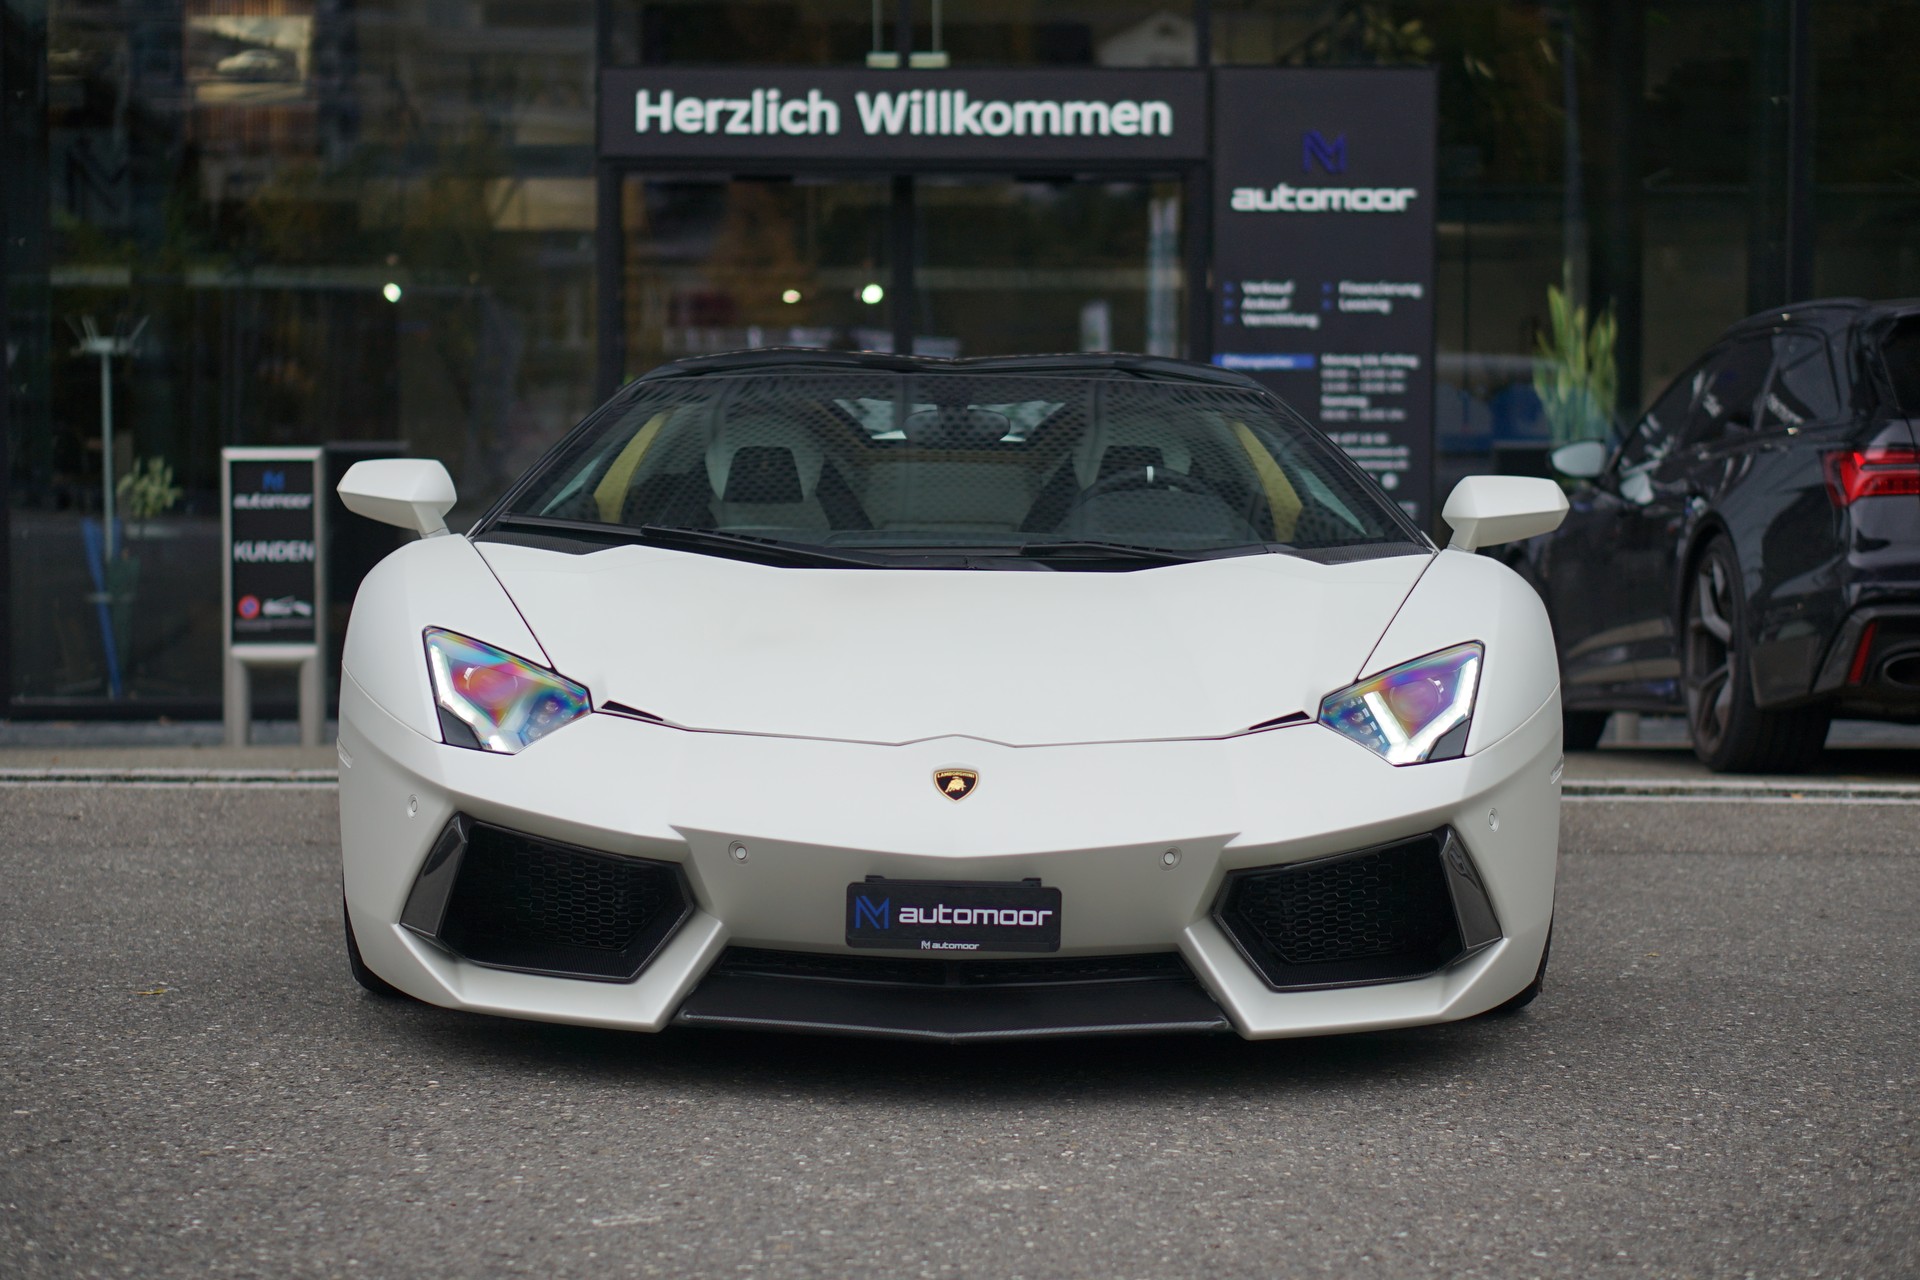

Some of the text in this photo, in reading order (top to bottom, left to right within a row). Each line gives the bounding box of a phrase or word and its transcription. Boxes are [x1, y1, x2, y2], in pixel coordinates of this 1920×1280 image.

[635, 89, 1173, 135] Herzlich Willkommen
[1231, 184, 1417, 211] automoor
[234, 541, 314, 562] KUNDEN
[899, 904, 1052, 926] automoor
[932, 941, 980, 950] automoor
